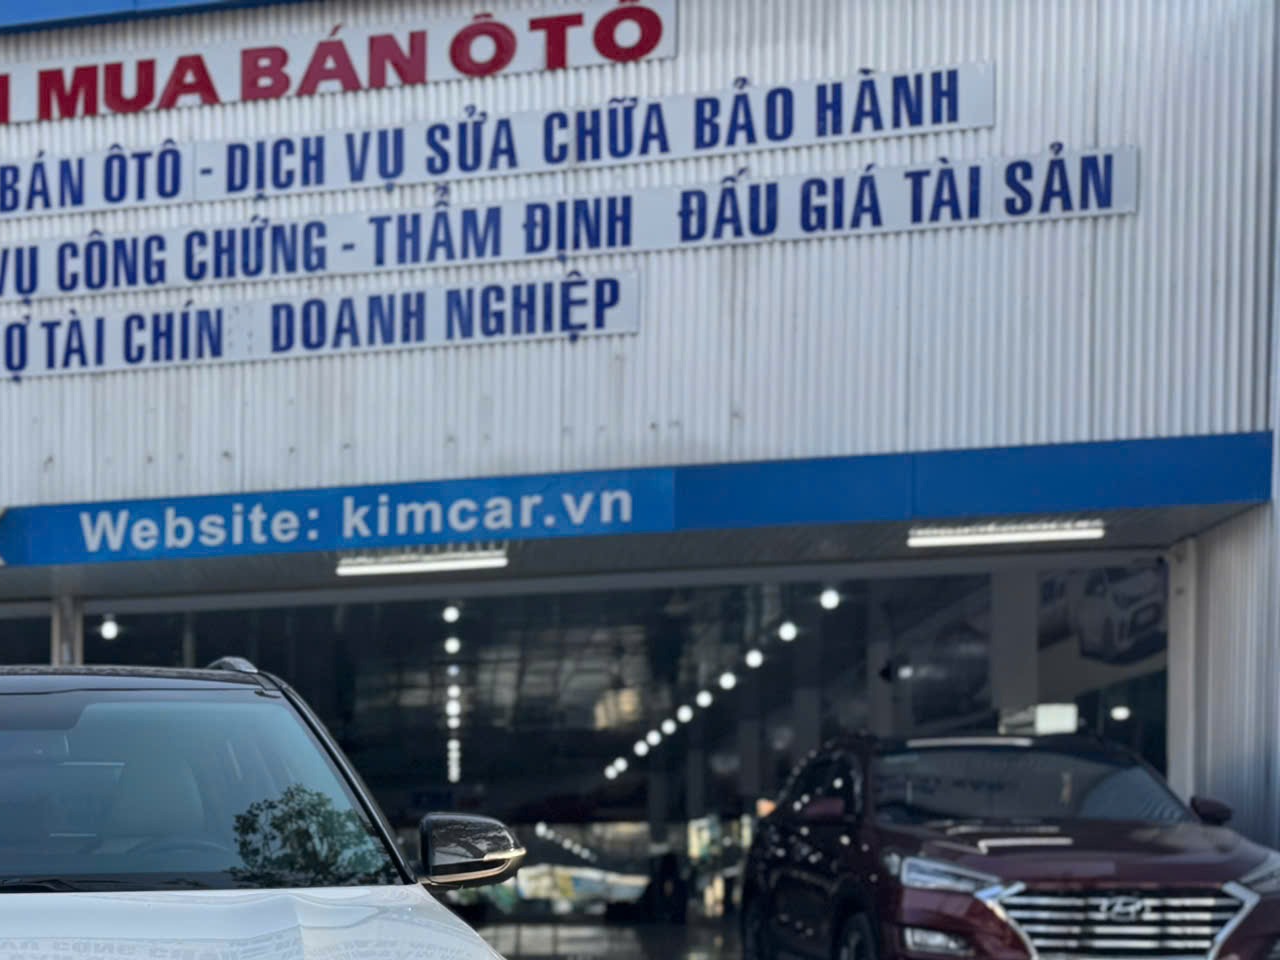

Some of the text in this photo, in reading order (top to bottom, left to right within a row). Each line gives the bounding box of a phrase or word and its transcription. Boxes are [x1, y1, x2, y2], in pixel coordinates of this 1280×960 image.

[37, 54, 220, 121] MUA
[240, 24, 427, 100] BÁN
[103, 138, 182, 203] ÔTÔ
[226, 135, 326, 200] DỊCH
[345, 127, 405, 193] VỤ
[425, 104, 519, 176] SỬA
[543, 97, 671, 166] CHỮA
[694, 76, 794, 150] BẢO
[816, 67, 959, 137] HÀNH
[57, 228, 167, 293] CÔNG
[184, 215, 328, 282] CHỨNG
[368, 184, 503, 267] THẨM
[522, 195, 633, 263] ĐỊNH
[678, 167, 779, 243] ĐẤU
[799, 163, 883, 233] GIÁ
[904, 156, 982, 224] TÀI
[1003, 142, 1114, 217] SẢN
[41, 308, 105, 371] TÀI
[124, 299, 223, 365] CHÍN
[271, 291, 426, 354] DOANH
[446, 270, 621, 343] NGHIỆP
[78, 489, 632, 553] Website: kimcar.vn
